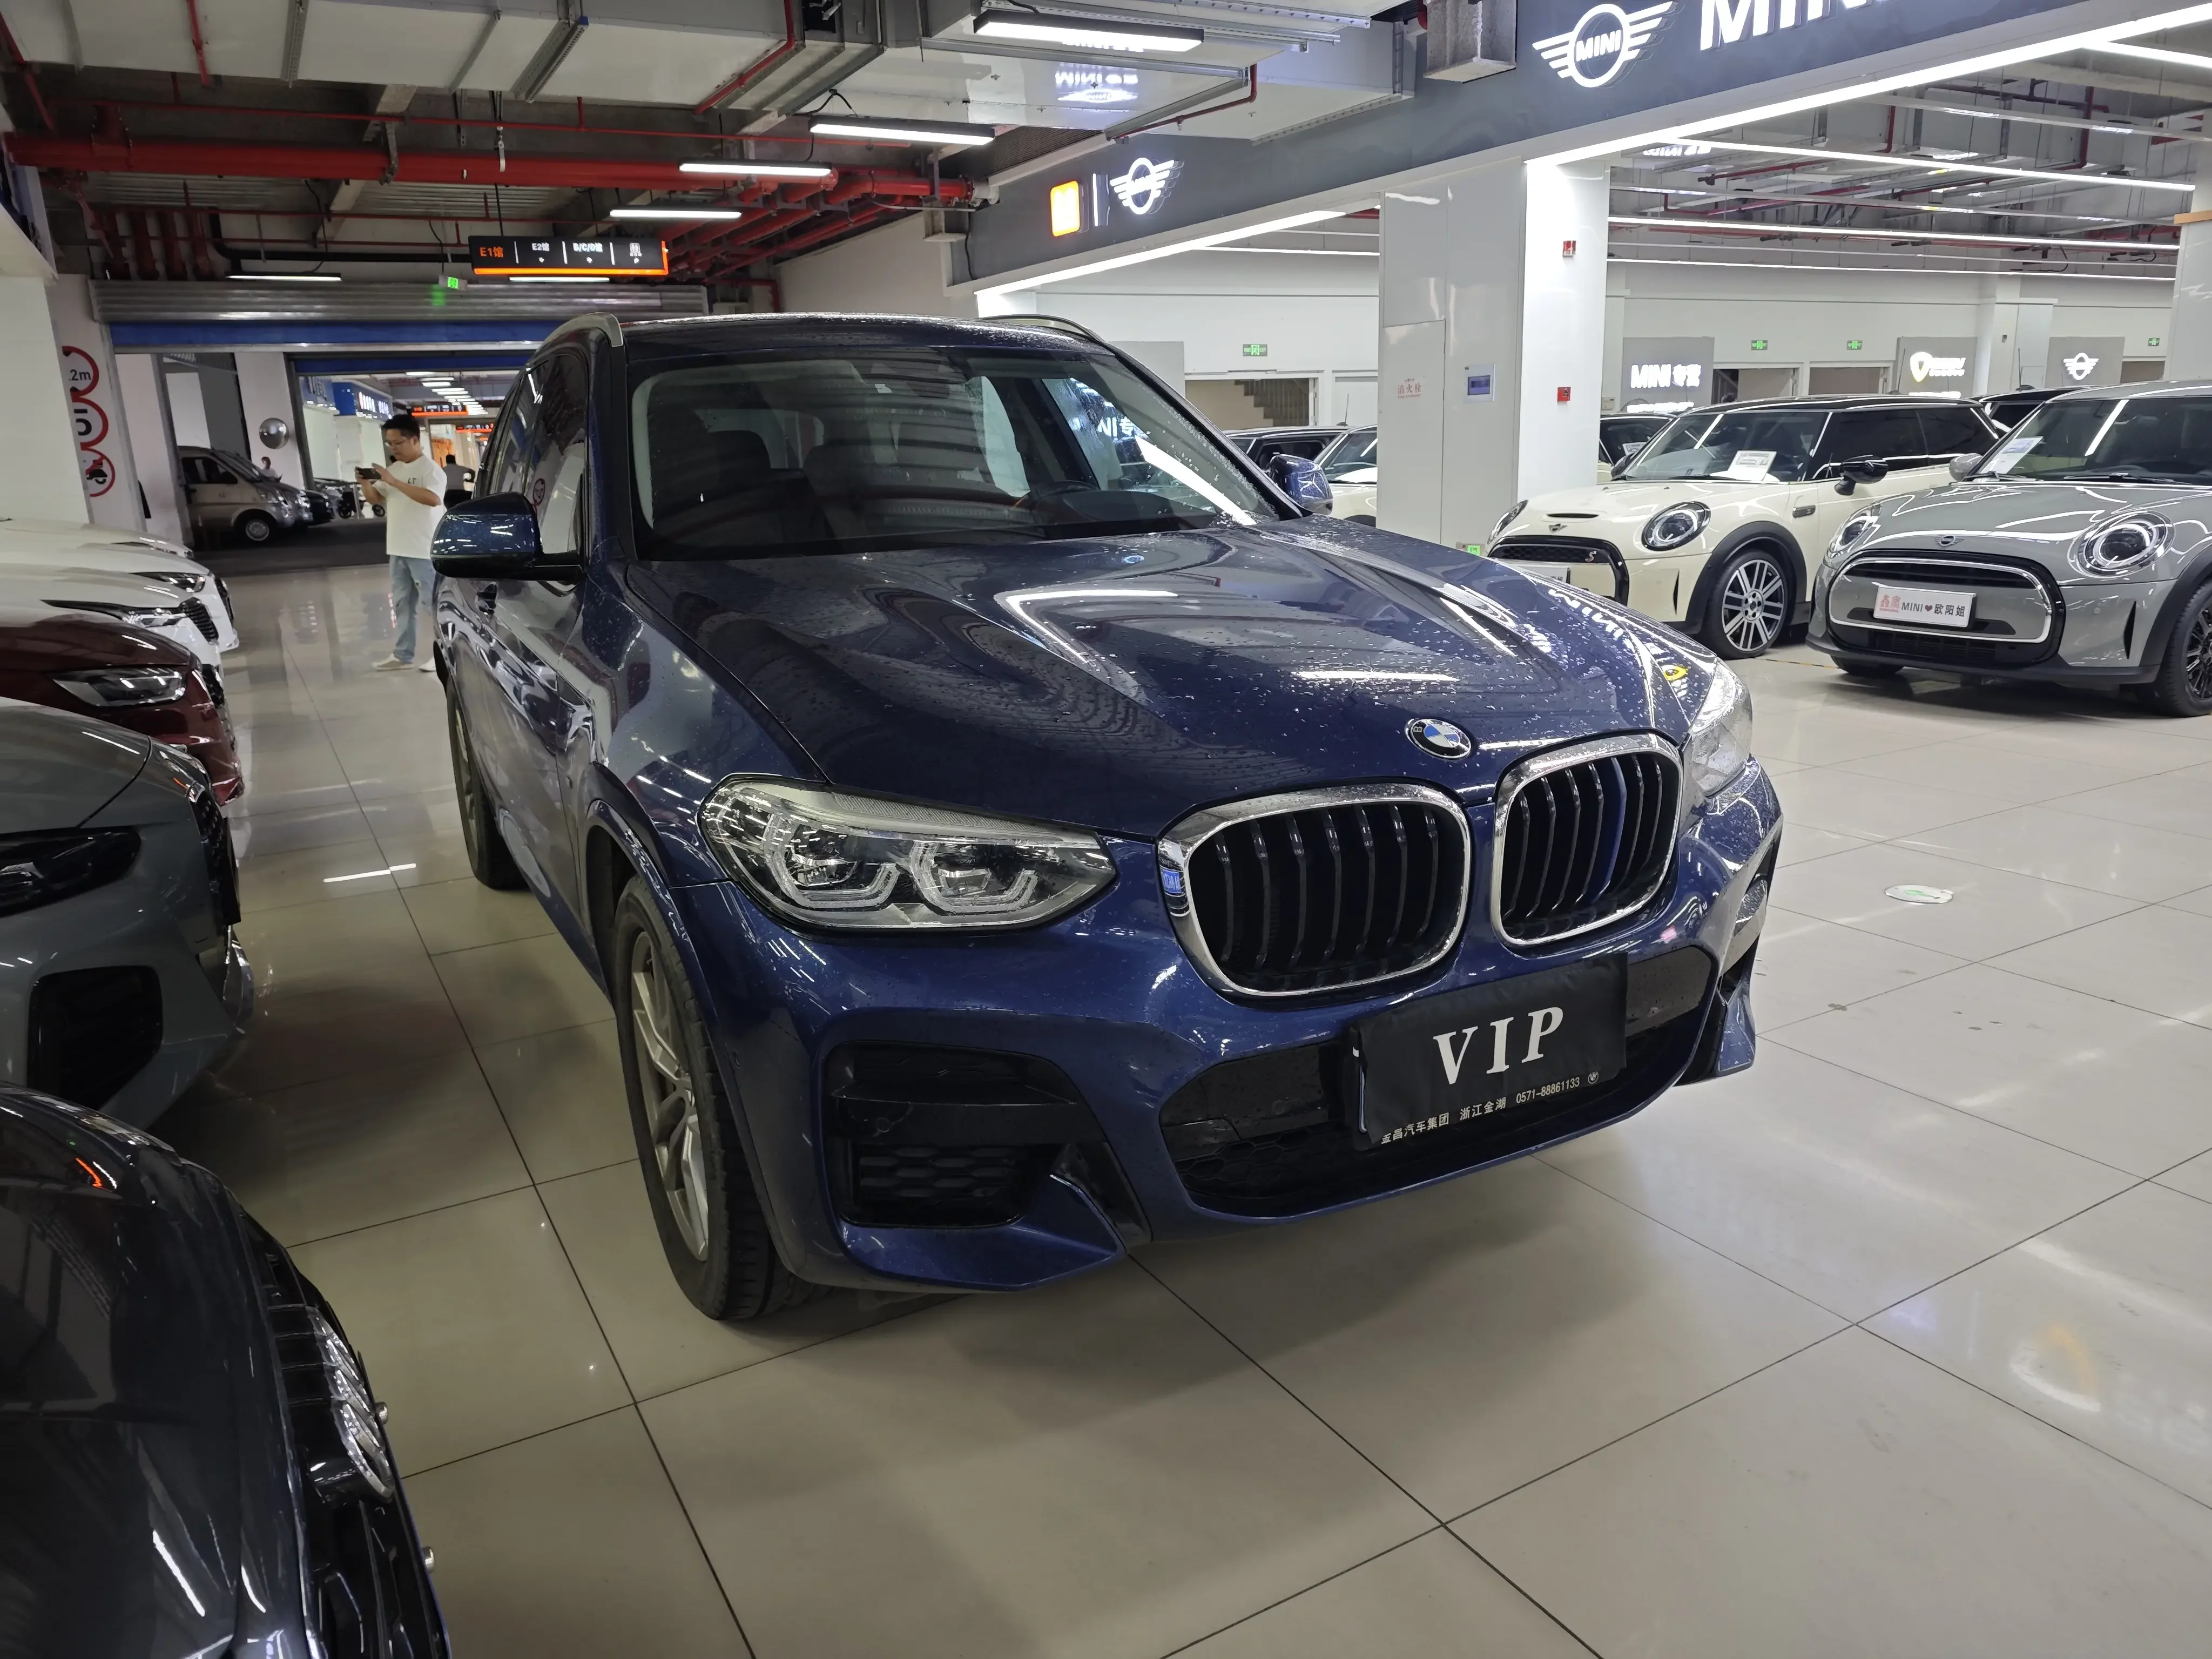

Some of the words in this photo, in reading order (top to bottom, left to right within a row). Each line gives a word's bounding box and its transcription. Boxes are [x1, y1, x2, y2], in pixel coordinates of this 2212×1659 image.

[1576, 29, 1621, 62] MINI
[480, 246, 504, 258] E1馆
[1631, 363, 1671, 388] MINI
[1397, 382, 1421, 394] 消火栓
[1585, 550, 1597, 562] S
[1901, 602, 1924, 612] MINI
[1934, 604, 1965, 617] 欧阳姐
[1433, 1007, 1563, 1085] VIP
[1459, 1097, 1507, 1121] 浙江金湖
[1516, 1077, 1580, 1104] 0571-88861133
